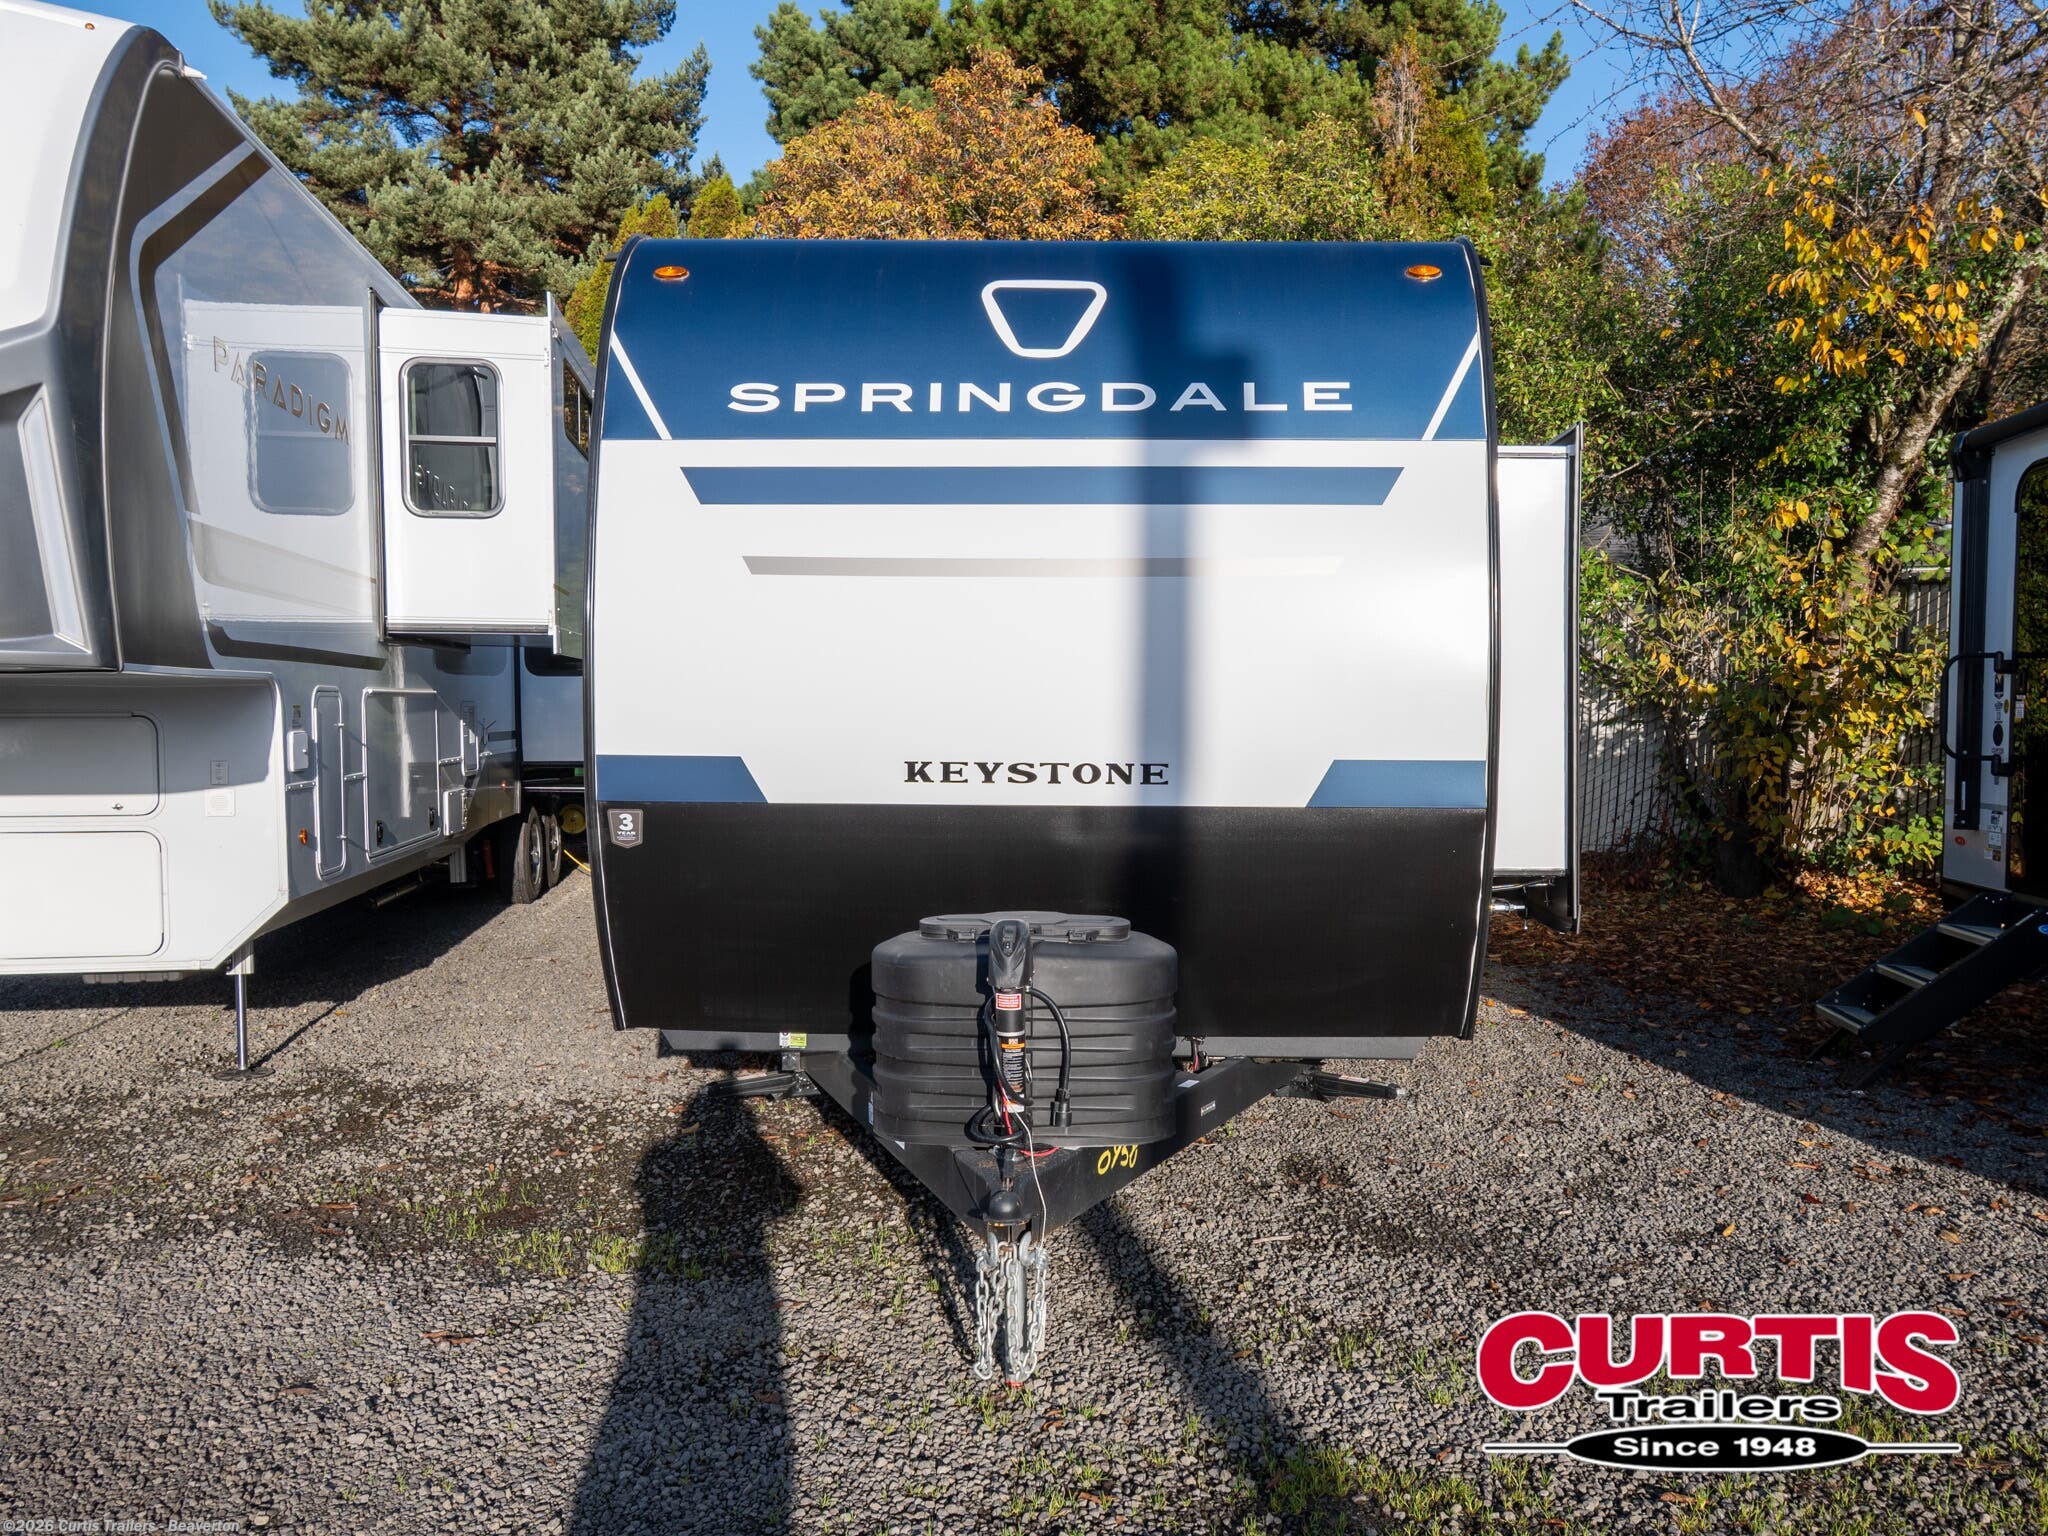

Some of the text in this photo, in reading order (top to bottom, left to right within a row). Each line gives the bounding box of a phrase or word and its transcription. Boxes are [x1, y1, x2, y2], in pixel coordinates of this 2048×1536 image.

[213, 335, 349, 446] PARADIGM
[727, 381, 1354, 414] SPRINGDALE
[903, 760, 1170, 786] KEYSTONE
[618, 813, 634, 831] 3
